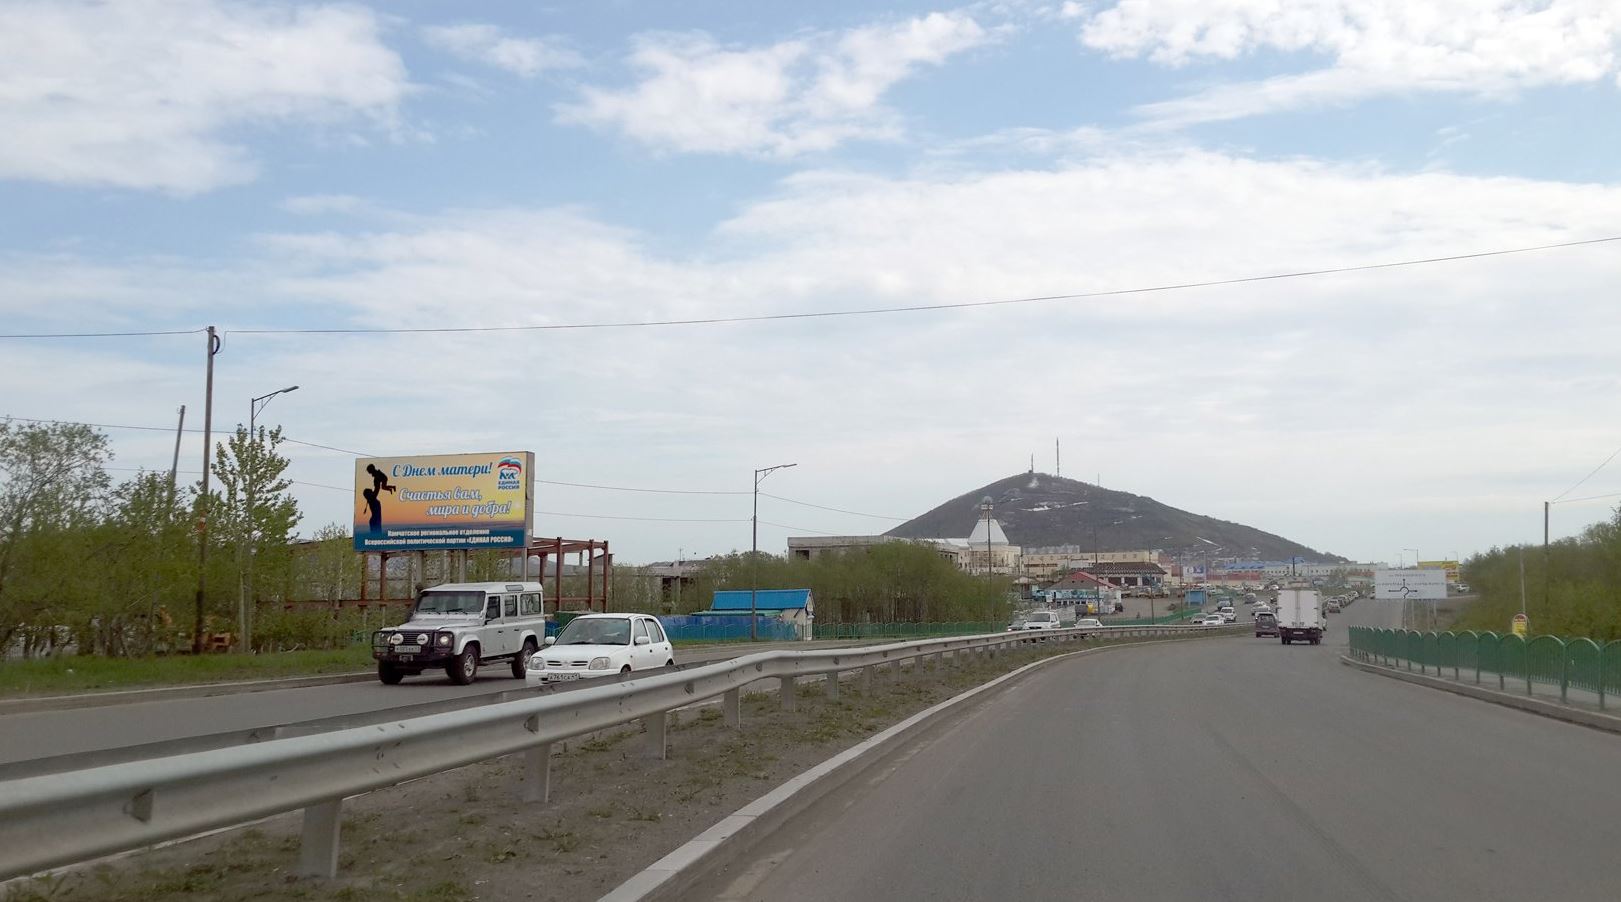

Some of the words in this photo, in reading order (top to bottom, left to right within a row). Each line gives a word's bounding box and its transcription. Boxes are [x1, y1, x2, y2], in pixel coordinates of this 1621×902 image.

[392, 464, 400, 477] С
[403, 463, 436, 477] Днем
[439, 462, 493, 478] матери!
[400, 488, 451, 501] Счастья
[453, 486, 482, 501] вам,
[427, 505, 460, 518] мира
[461, 506, 469, 514] и
[472, 500, 512, 518] добра!
